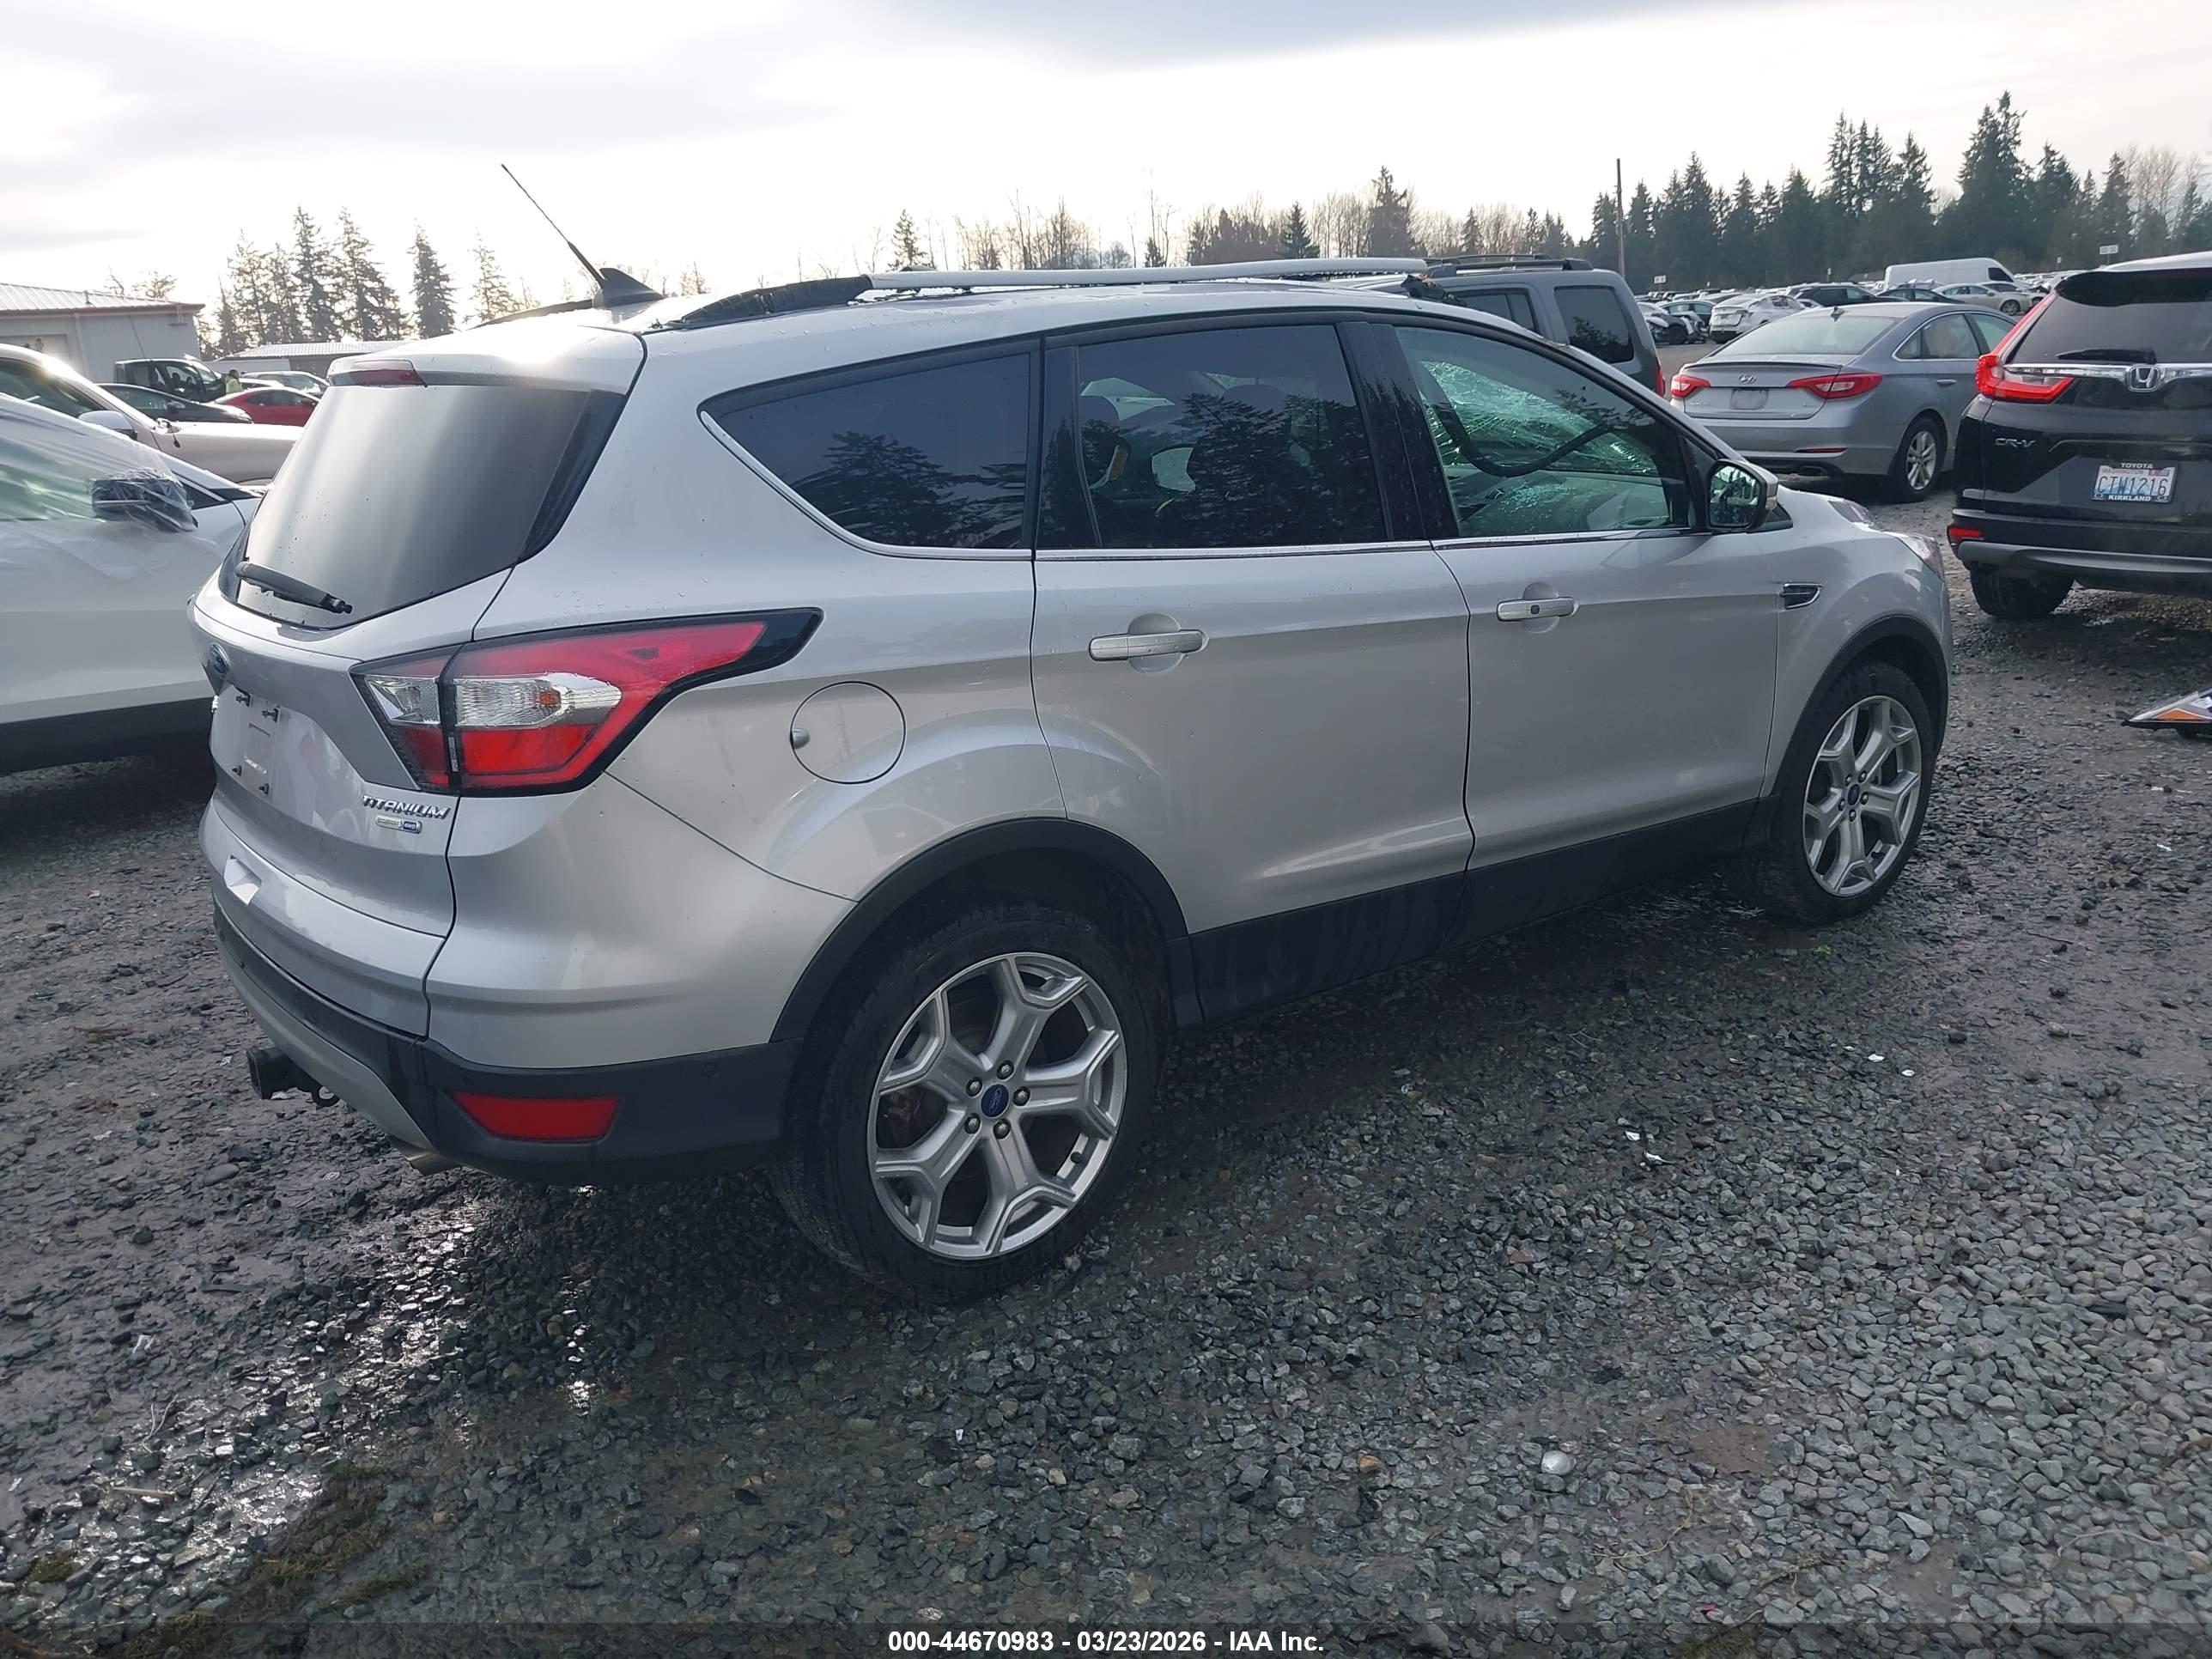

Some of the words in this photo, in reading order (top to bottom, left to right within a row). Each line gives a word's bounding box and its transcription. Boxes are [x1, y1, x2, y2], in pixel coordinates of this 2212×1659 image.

[1995, 438, 2036, 447] CR-V
[2097, 476, 2169, 495] CTW1216
[362, 794, 451, 819] TITANIUM
